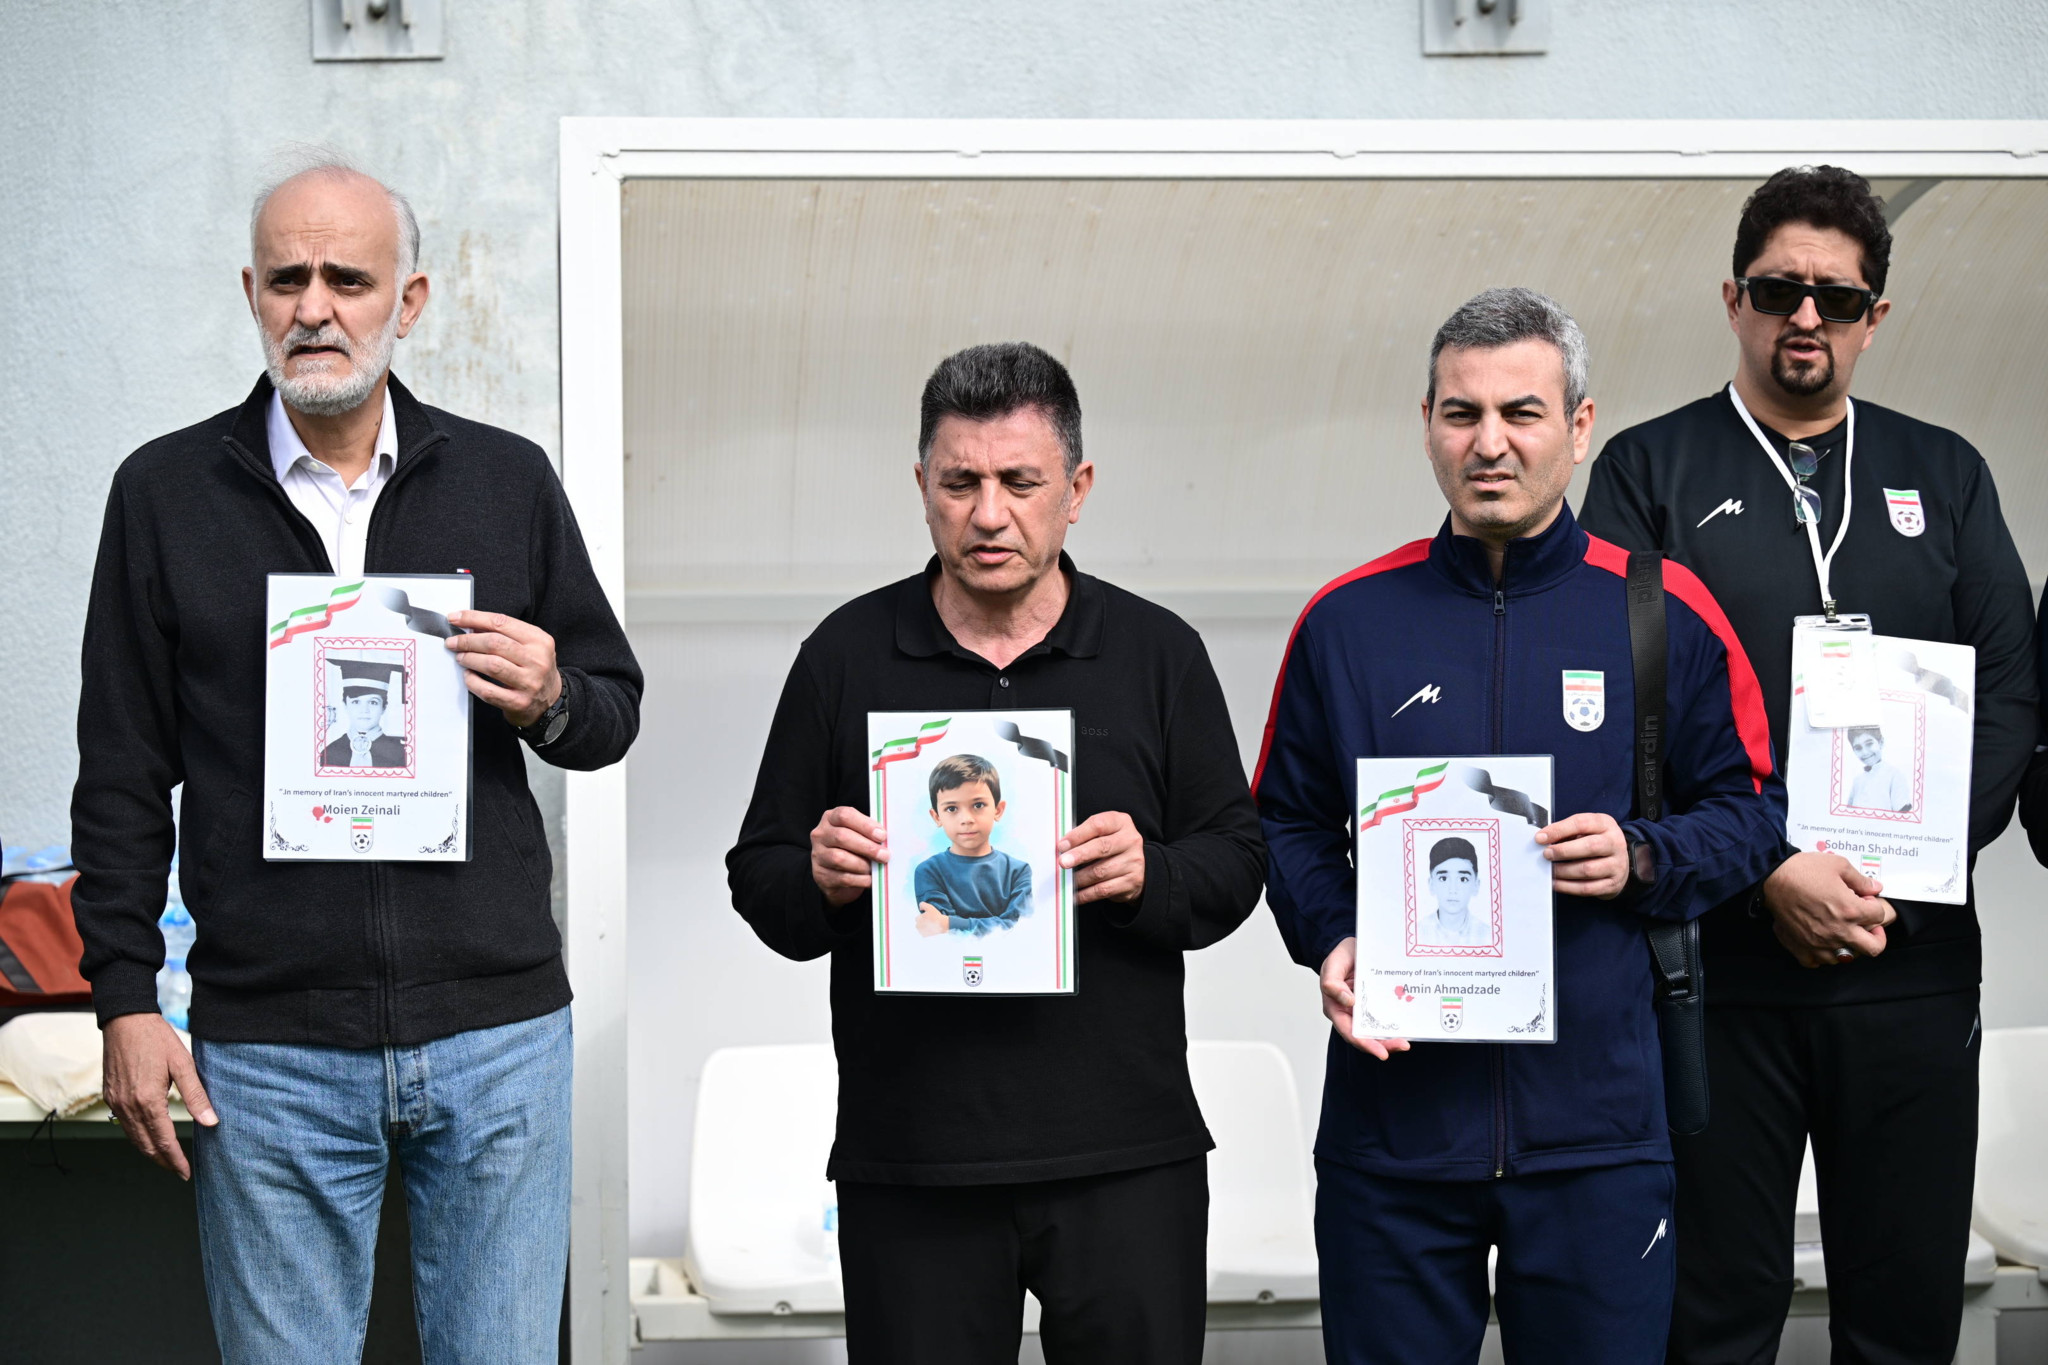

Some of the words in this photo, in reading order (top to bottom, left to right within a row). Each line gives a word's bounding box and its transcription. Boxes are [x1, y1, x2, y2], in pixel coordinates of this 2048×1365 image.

[1081, 726, 1109, 736] BOSS
[1640, 715, 1659, 797] cardin
[386, 791, 418, 799] martyred
[323, 804, 358, 815] Moien
[361, 805, 400, 815] Zeinali
[1810, 825, 1837, 834] memory
[1846, 827, 1864, 836] Iran's
[1865, 831, 1892, 839] innocent
[1893, 833, 1923, 842] martyred
[1825, 839, 1865, 852] Sobhan
[1868, 844, 1919, 857] Shahdadi
[1475, 970, 1507, 978] martyred
[1402, 984, 1431, 994] Amin
[1434, 984, 1500, 995] Ahmadzade
